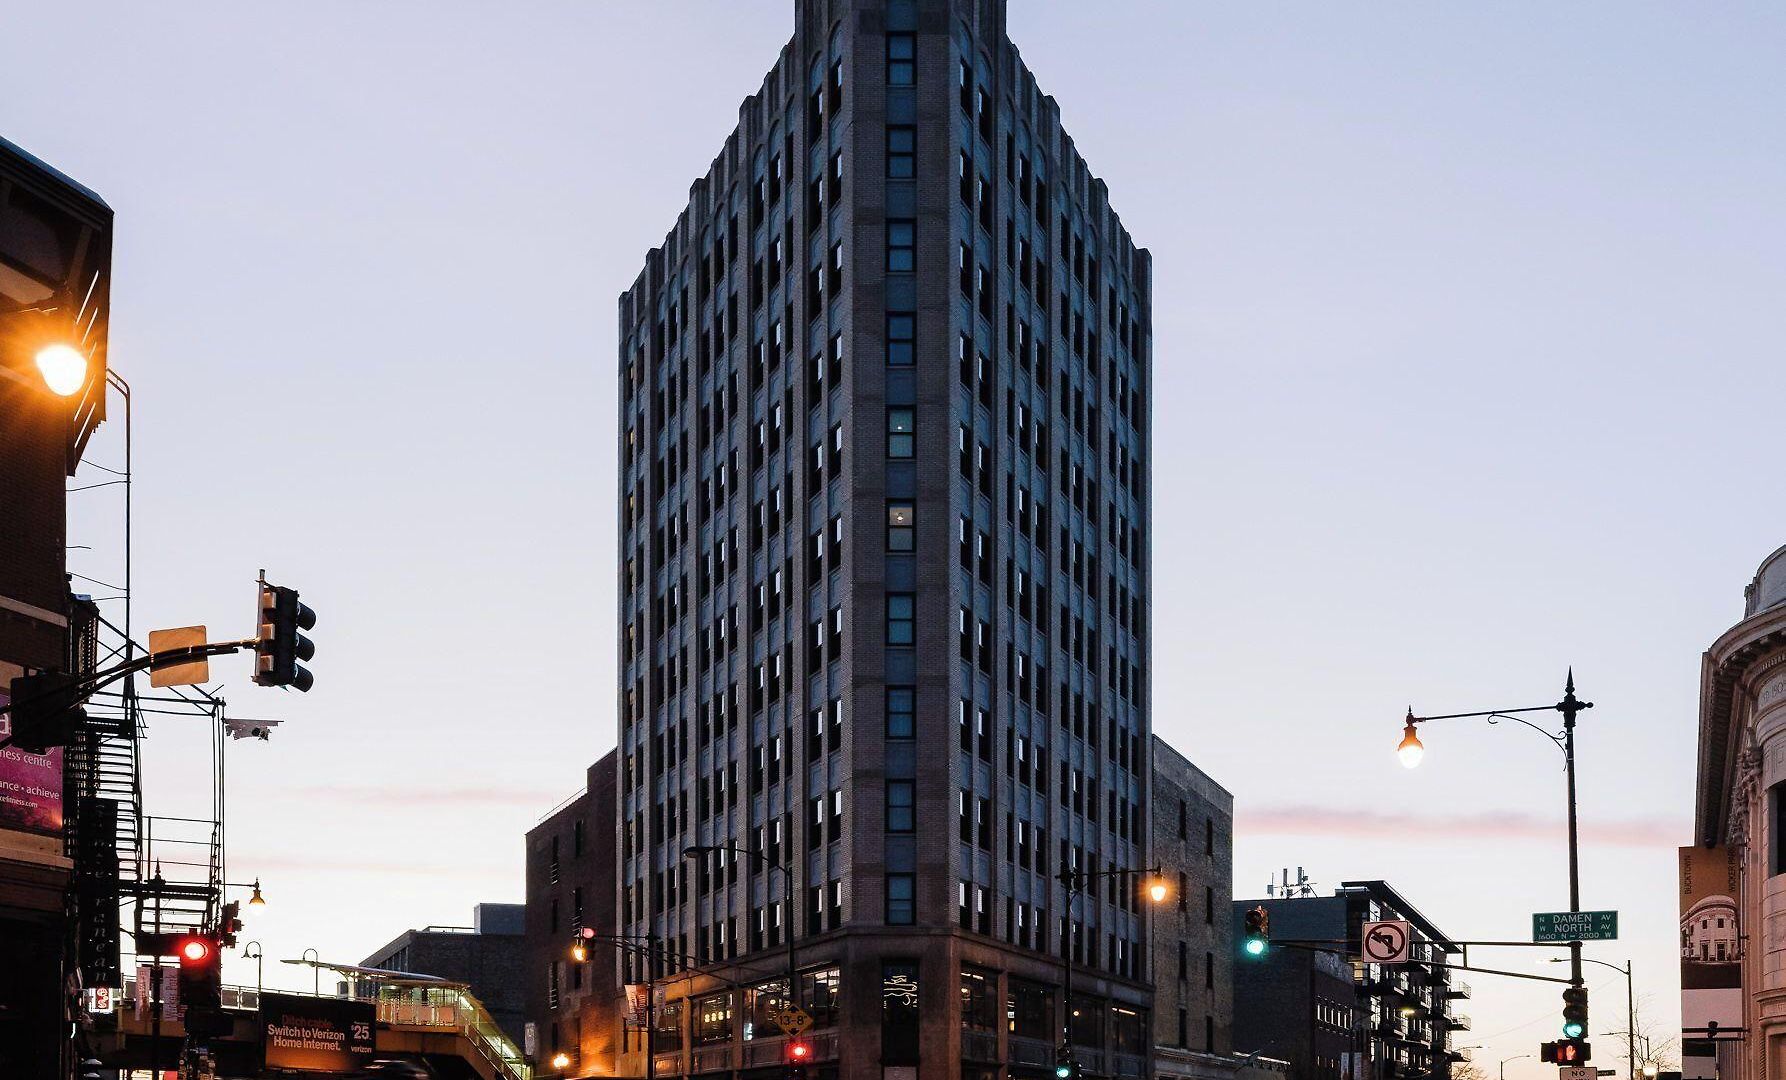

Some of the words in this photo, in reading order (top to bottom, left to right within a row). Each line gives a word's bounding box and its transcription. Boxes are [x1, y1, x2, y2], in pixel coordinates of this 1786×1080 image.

[23, 755, 52, 769] centre
[26, 786, 60, 800] achieve
[1553, 914, 1592, 923] DAMEN
[1554, 923, 1592, 933] NORTH
[267, 1023, 300, 1037] Switch
[302, 1027, 311, 1037] to
[311, 1028, 345, 1041] Verizon
[273, 1036, 302, 1048] Home
[303, 1038, 341, 1051] Internet.
[351, 1045, 373, 1054] verizon
